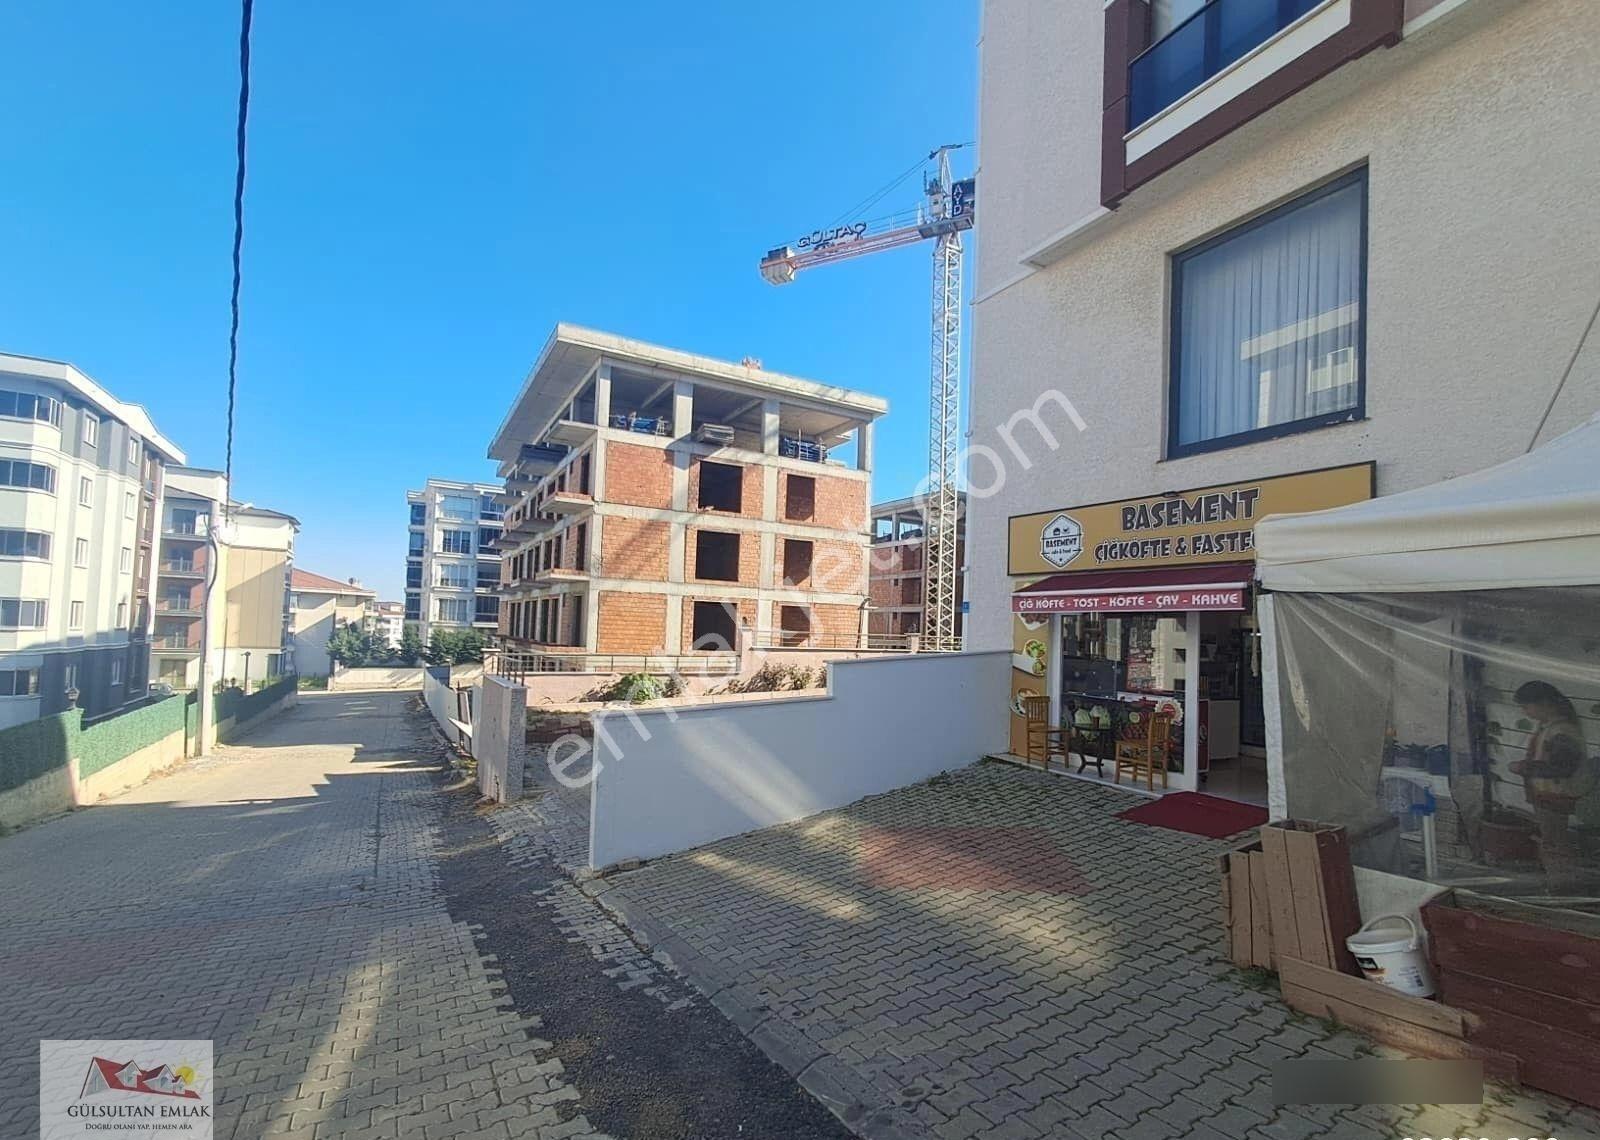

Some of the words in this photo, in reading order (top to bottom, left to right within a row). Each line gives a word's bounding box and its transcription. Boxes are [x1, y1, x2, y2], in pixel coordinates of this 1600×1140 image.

[1121, 487, 1260, 532] BASEMENT
[1045, 537, 1078, 548] BASEMENT
[1175, 536, 1187, 556] &
[1072, 597, 1100, 608] TOST
[1155, 594, 1180, 608] ÇAY
[1191, 593, 1239, 605] KAHVE
